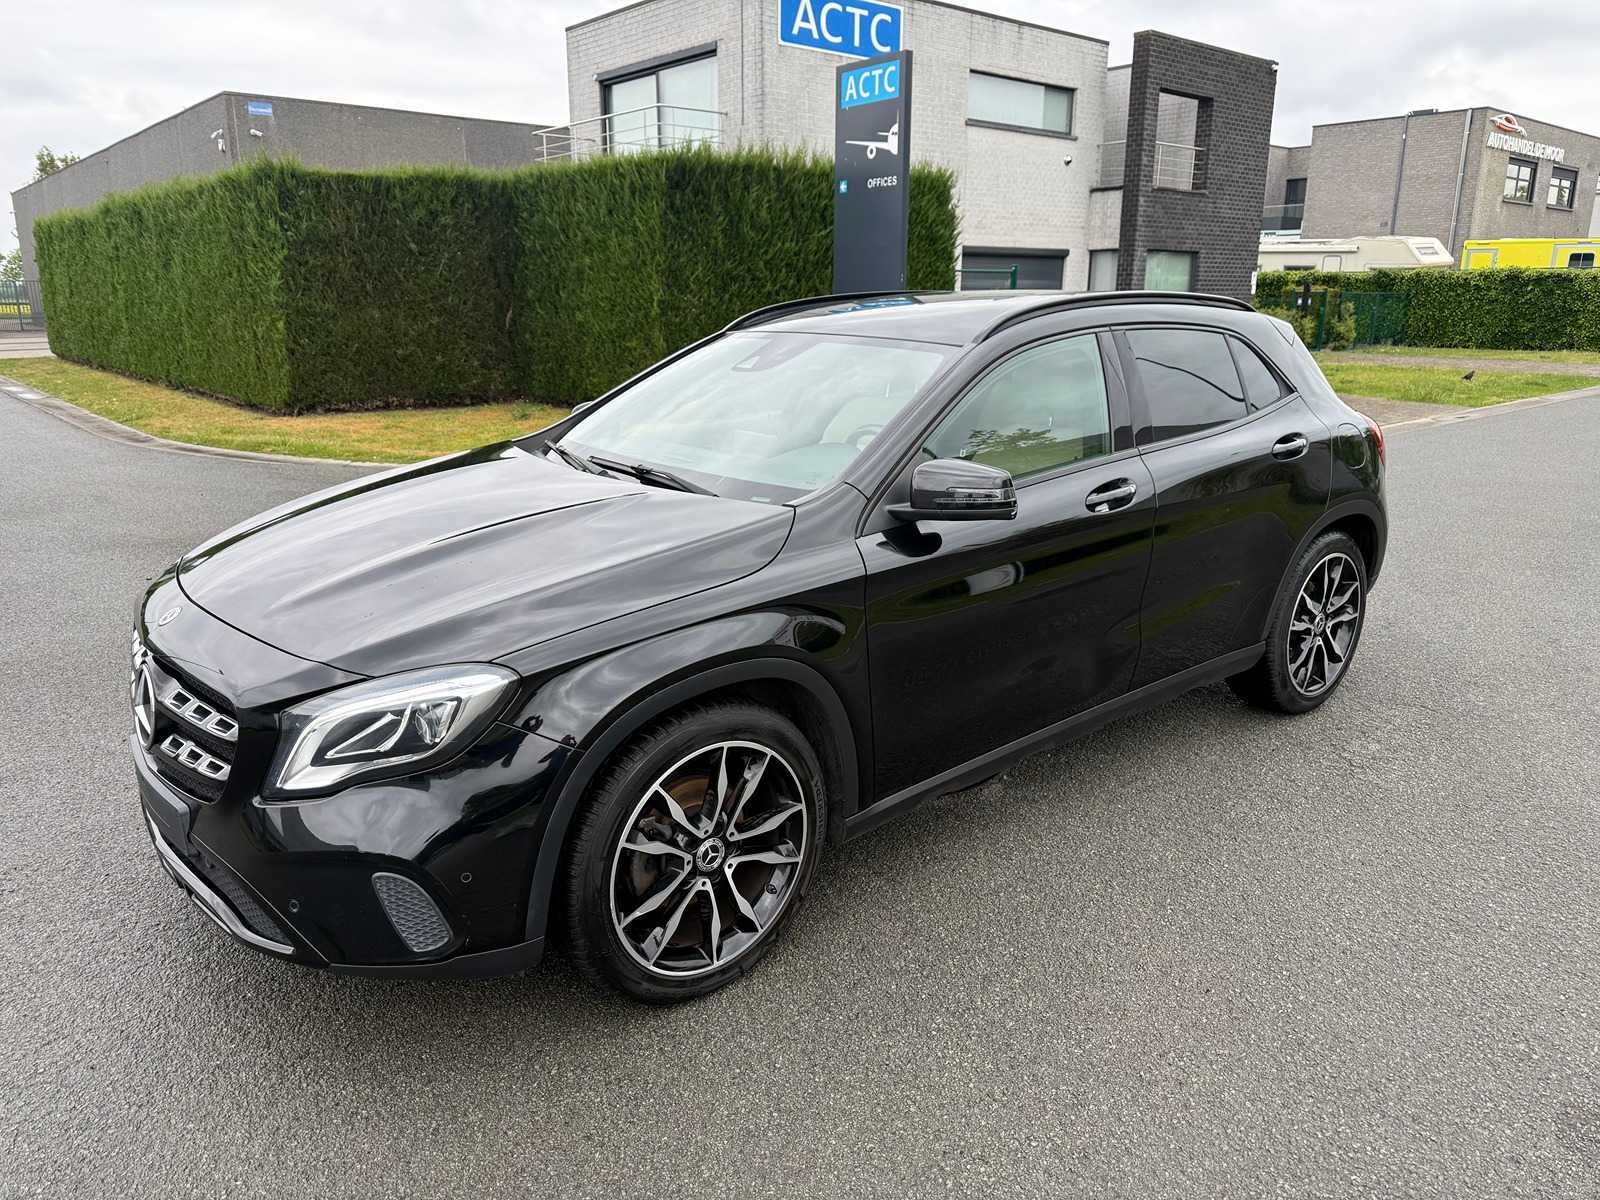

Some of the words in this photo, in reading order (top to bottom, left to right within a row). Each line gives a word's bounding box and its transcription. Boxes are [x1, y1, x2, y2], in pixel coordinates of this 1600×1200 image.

[792, 0, 892, 52] ACTC
[845, 66, 896, 101] ACTC
[867, 175, 898, 189] OFFICES
